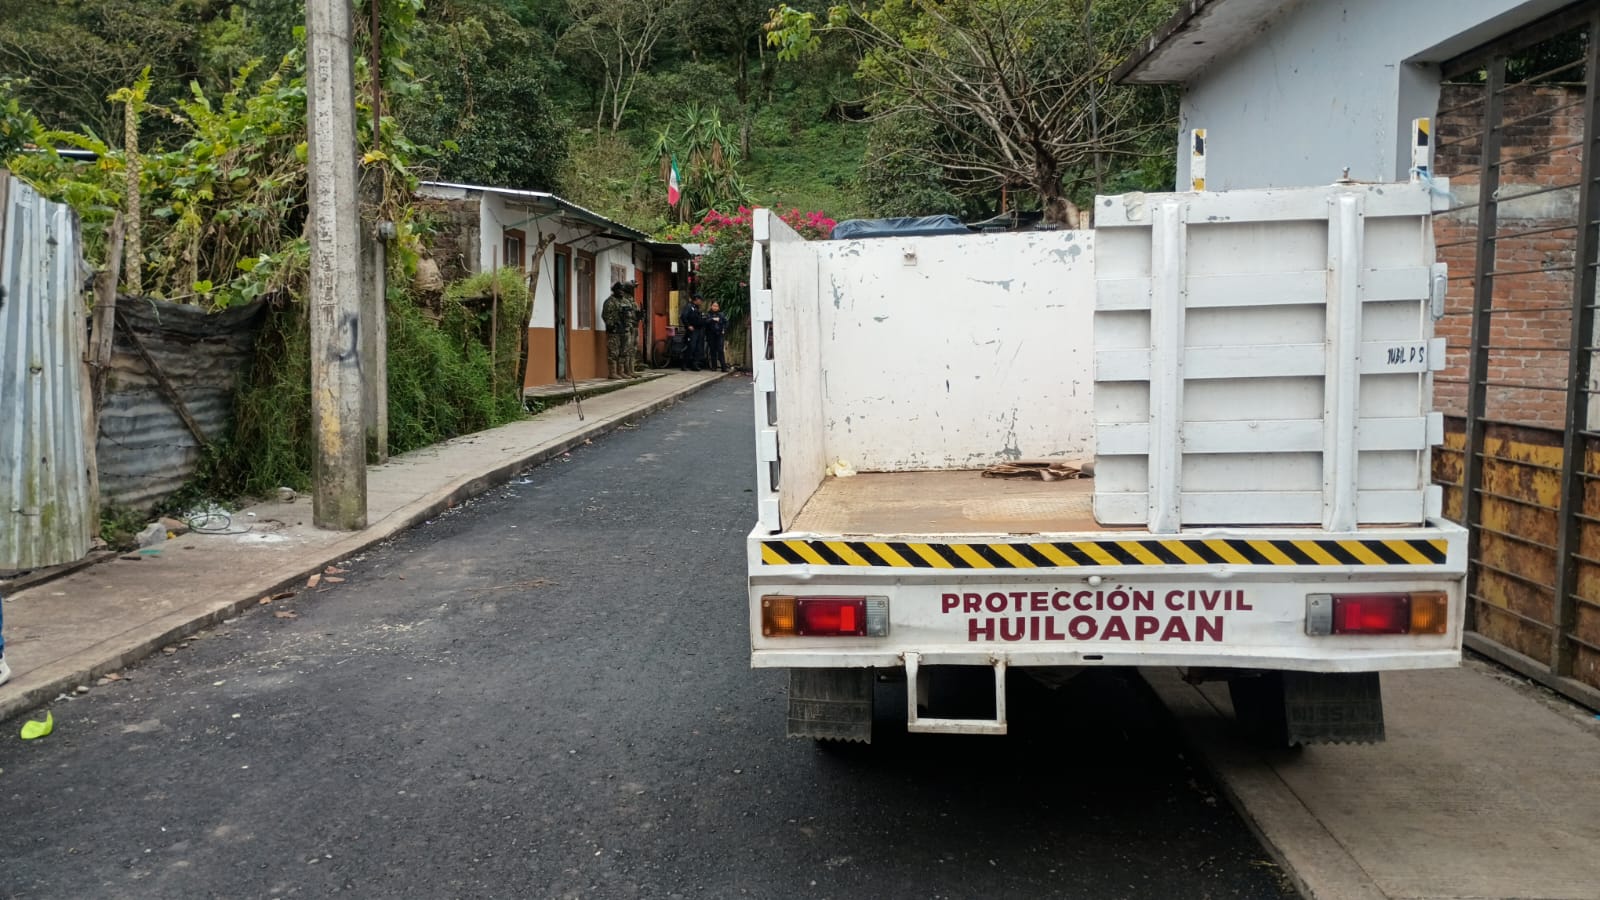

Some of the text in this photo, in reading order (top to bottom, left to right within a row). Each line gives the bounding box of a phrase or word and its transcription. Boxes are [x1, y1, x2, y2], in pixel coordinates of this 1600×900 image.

[941, 585, 1253, 613] PROTECCIÓN CIVIL
[968, 615, 1224, 642] HUILOAPAN
